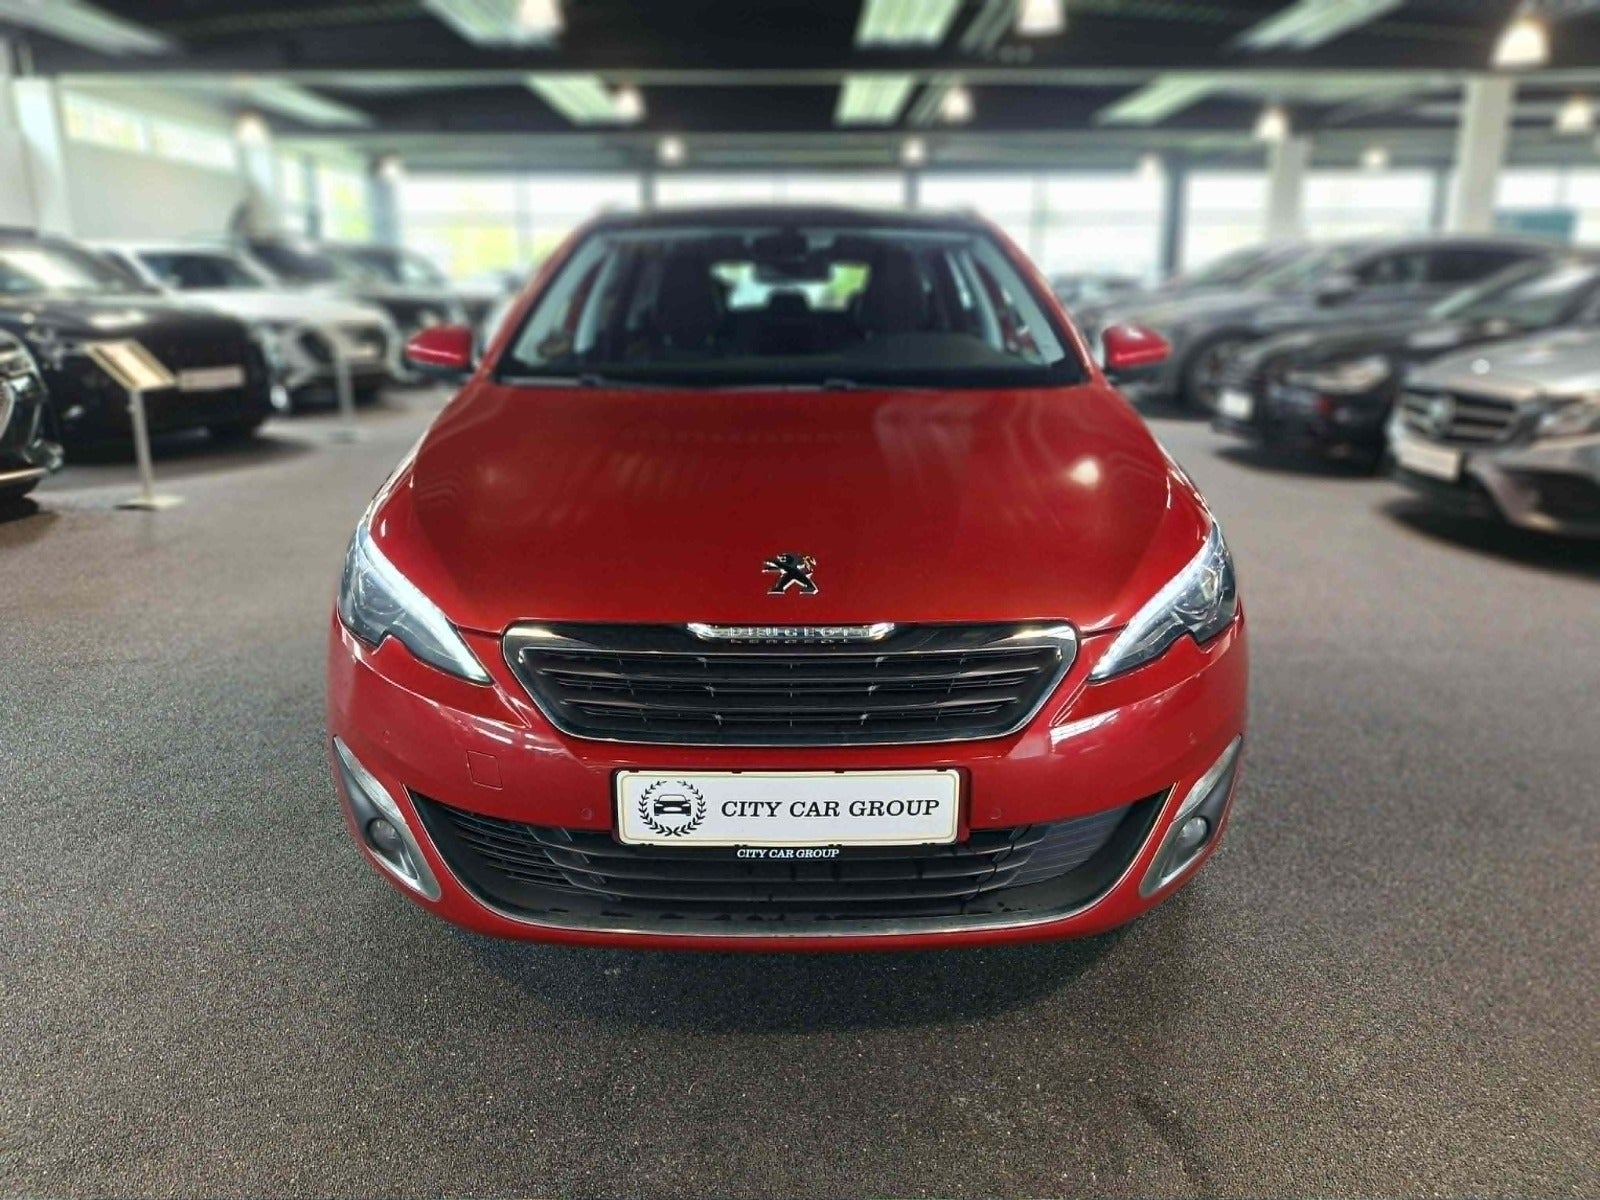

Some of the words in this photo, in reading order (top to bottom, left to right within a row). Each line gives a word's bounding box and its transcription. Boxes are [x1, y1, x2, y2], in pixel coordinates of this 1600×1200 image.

[721, 801, 782, 817] CITY
[789, 801, 841, 817] CAR
[848, 799, 940, 817] GROUP
[736, 848, 767, 858] CITY
[768, 848, 794, 858] CAR
[795, 848, 840, 858] GROUP
